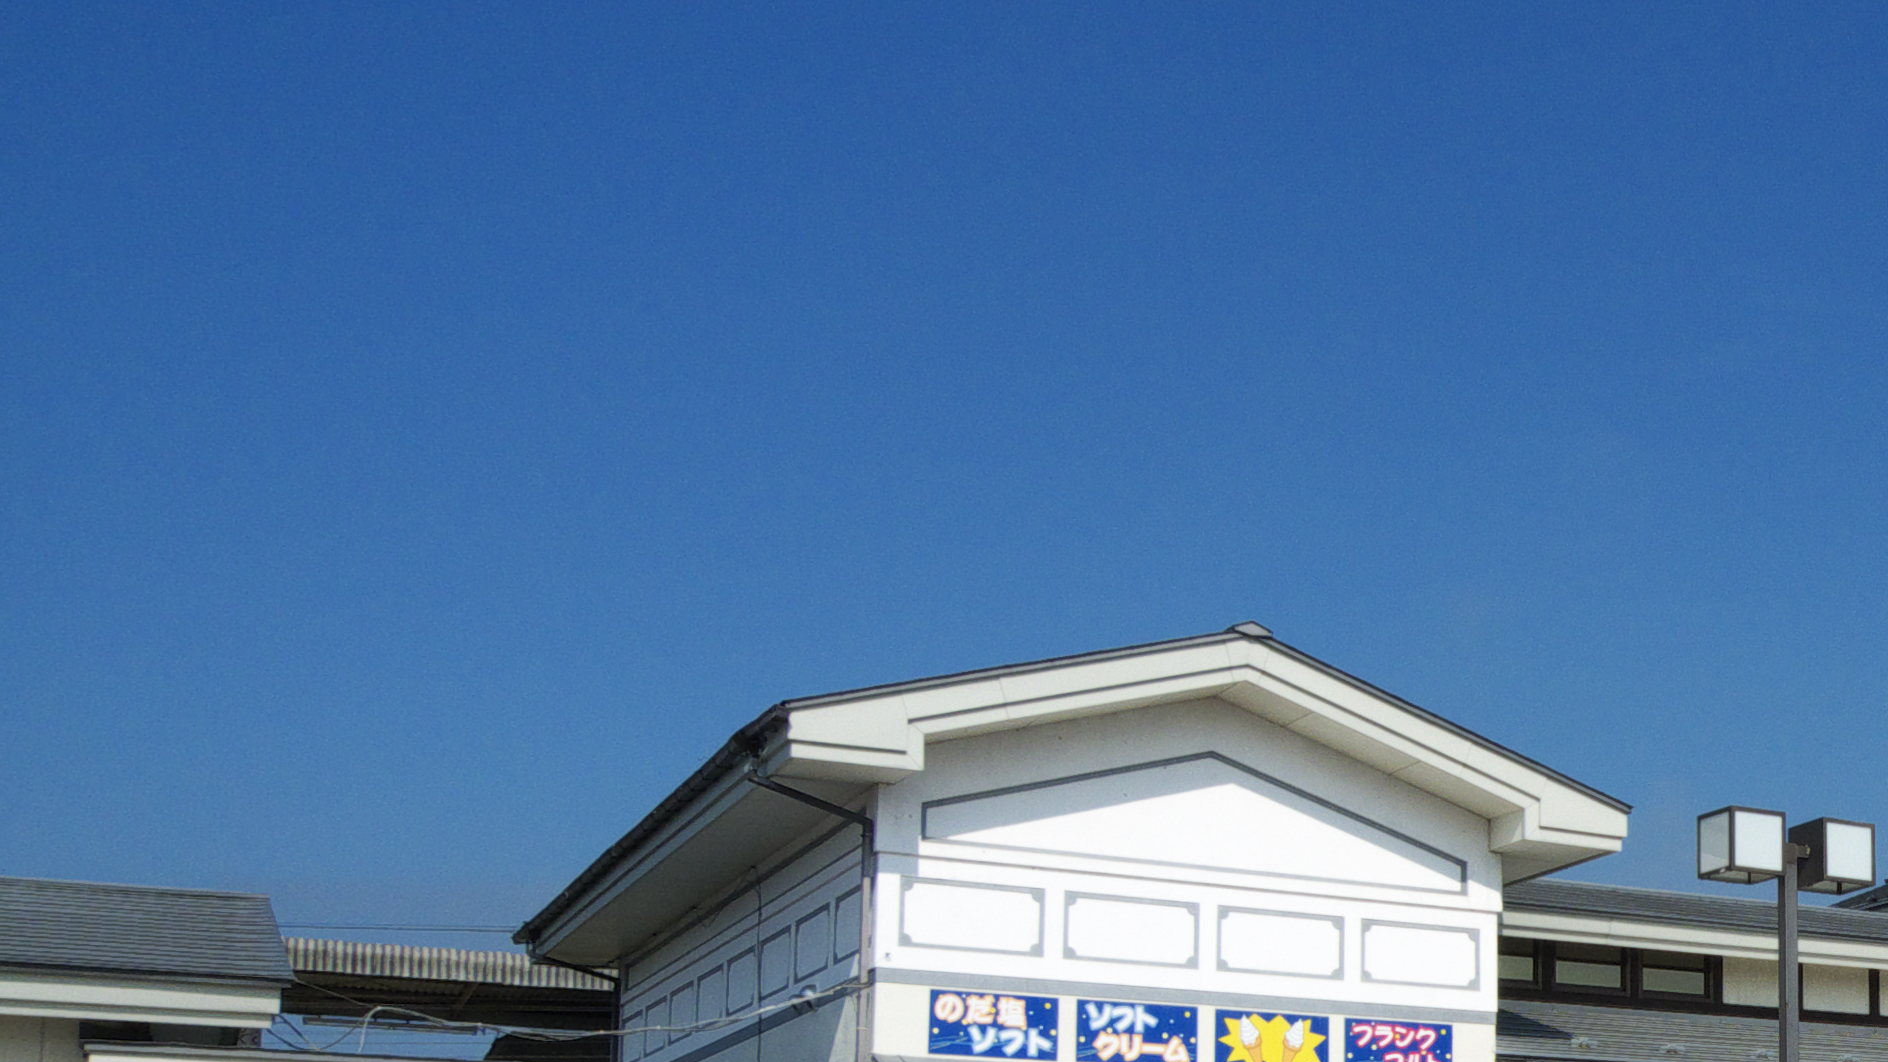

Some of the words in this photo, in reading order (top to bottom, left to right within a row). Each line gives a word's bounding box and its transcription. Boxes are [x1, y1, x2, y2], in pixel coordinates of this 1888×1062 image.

[934, 993, 1028, 1028] のだ塩
[1085, 1002, 1159, 1033] ソフト
[968, 1025, 1054, 1057] ソフト
[1352, 1023, 1438, 1050] フランク
